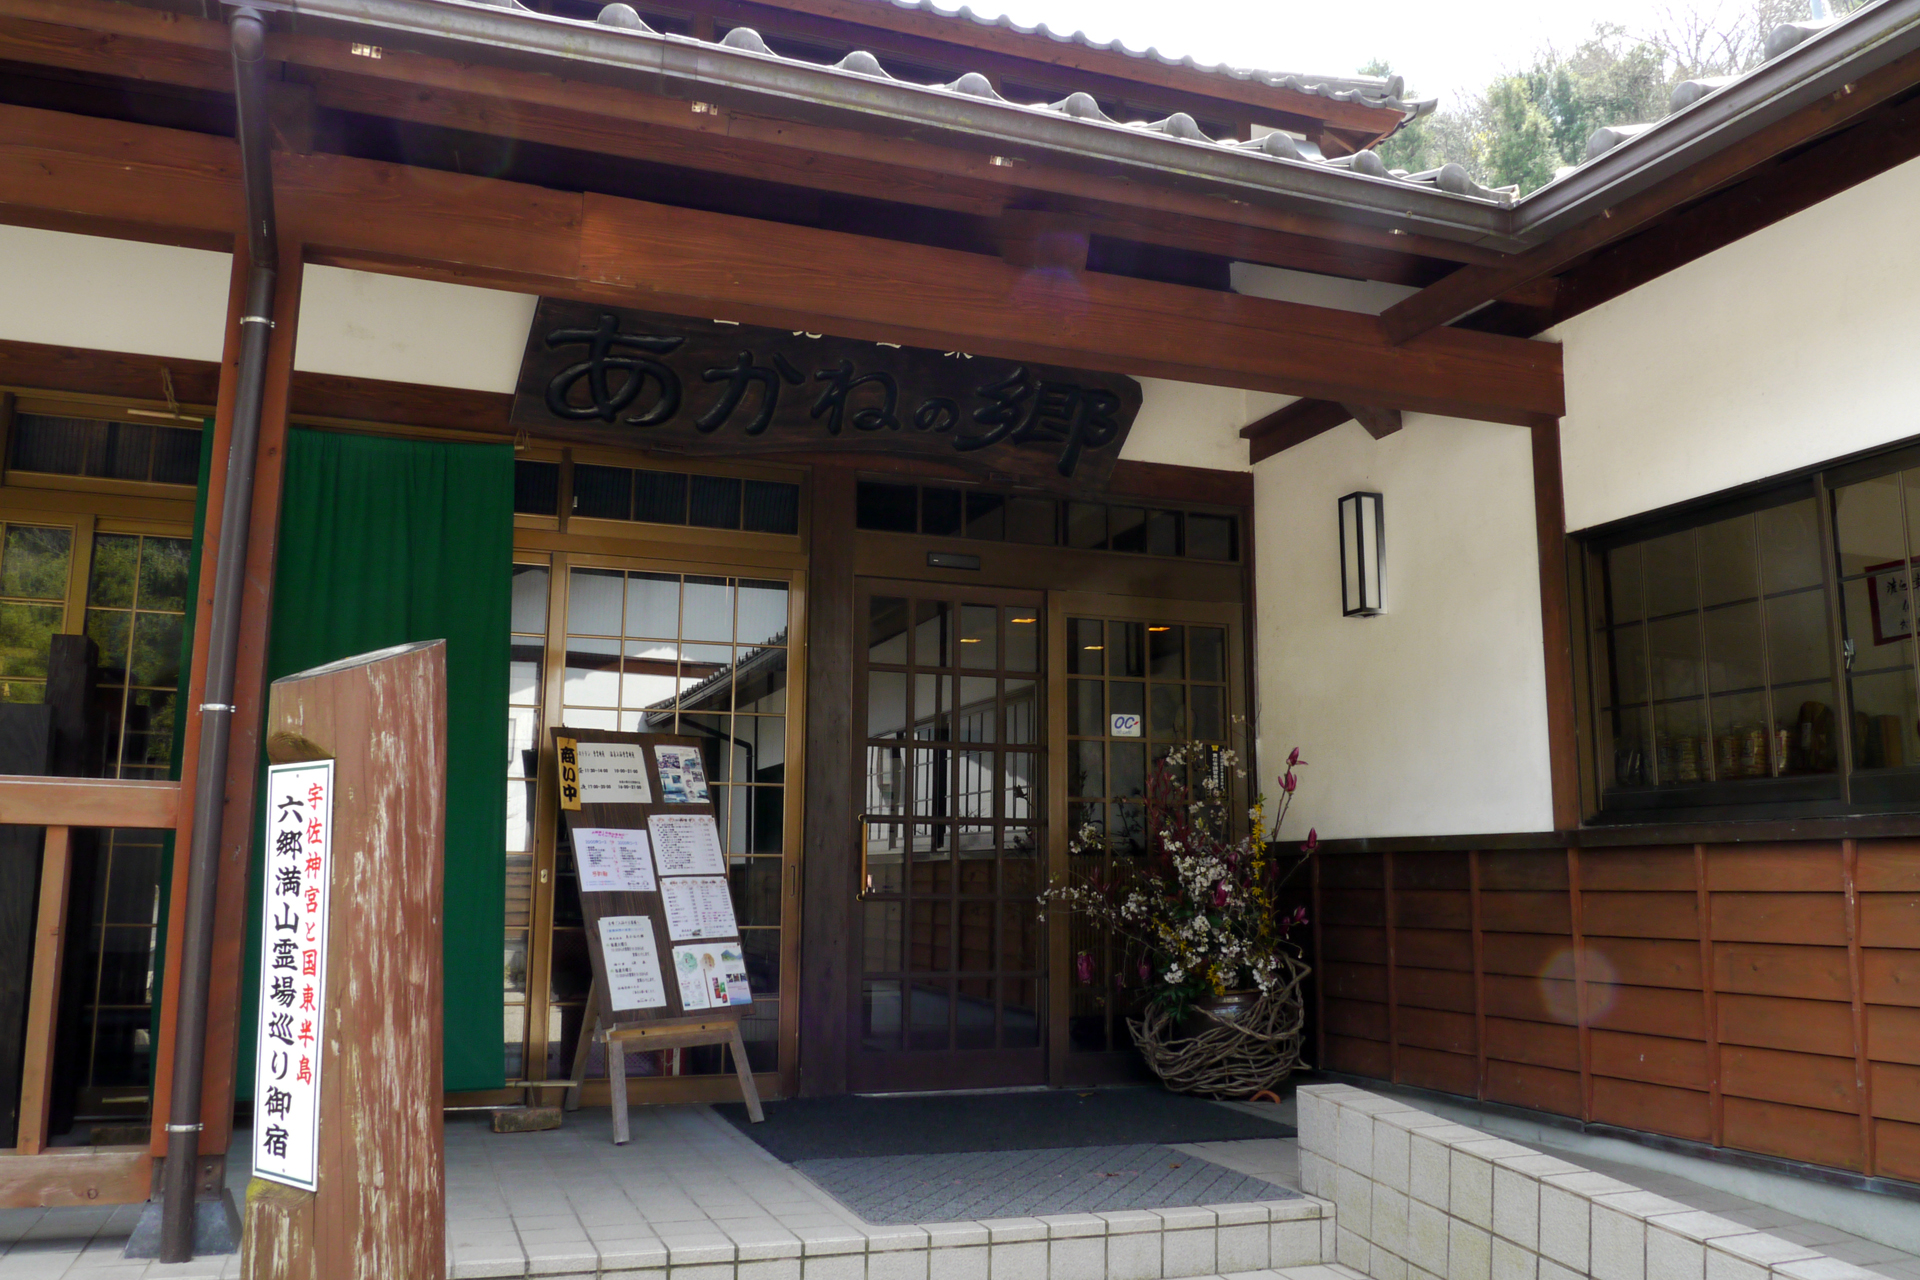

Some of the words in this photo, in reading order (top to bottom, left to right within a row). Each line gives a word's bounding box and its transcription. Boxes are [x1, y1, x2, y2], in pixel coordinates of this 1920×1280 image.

[545, 313, 1121, 478] あかねの郷
[560, 746, 578, 803] 商い中
[263, 795, 305, 1160] 六郷満山霊場巡り御宿
[296, 782, 324, 1087] 宇佐神宮と国東半島
